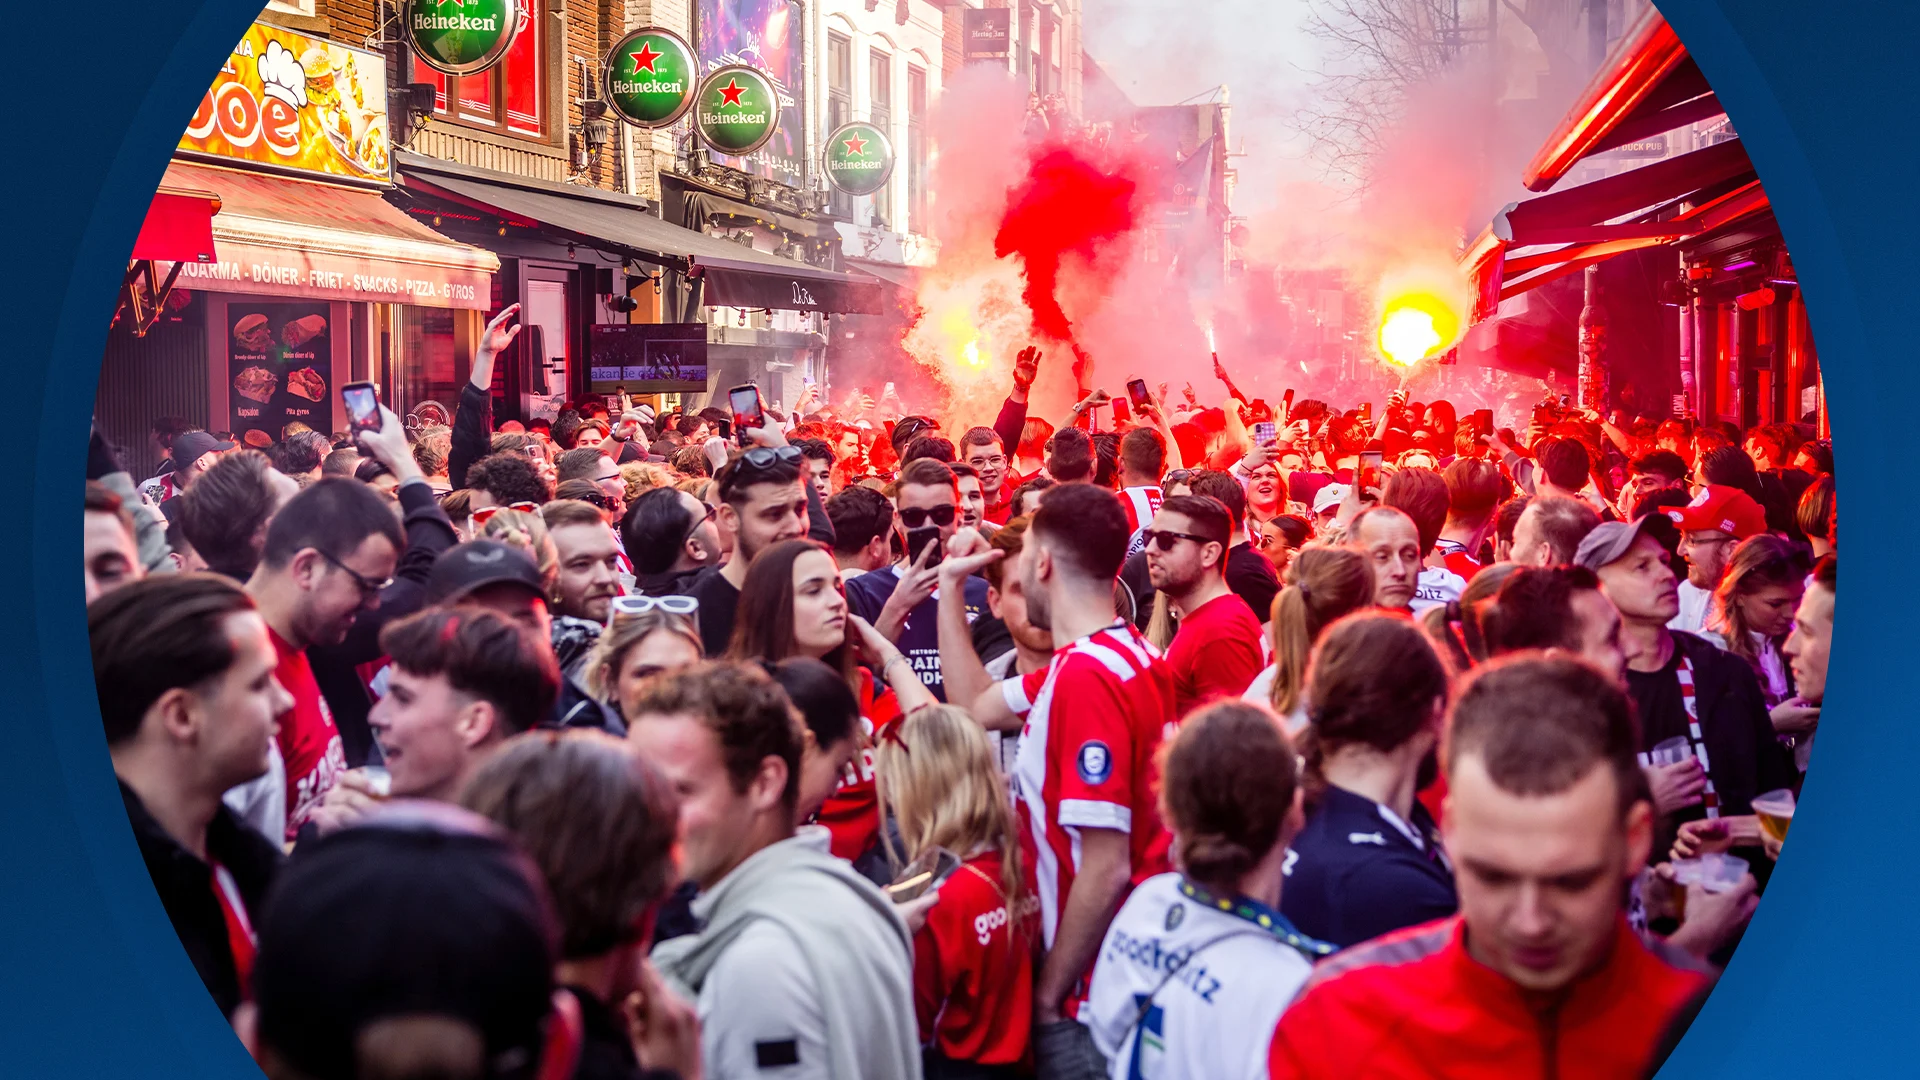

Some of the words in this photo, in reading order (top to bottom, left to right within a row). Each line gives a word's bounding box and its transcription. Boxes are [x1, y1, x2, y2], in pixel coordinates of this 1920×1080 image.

[414, 13, 496, 31] Heineken
[613, 78, 682, 94] Heineken
[702, 111, 765, 125] Heineken
[1622, 143, 1644, 151] DUCK
[1645, 142, 1663, 150] PUB
[831, 160, 882, 170] Heineken
[252, 261, 299, 286] DÖNER
[309, 270, 344, 290] FRIET
[353, 273, 398, 294] SNACKS
[405, 279, 436, 297] PIZZA
[443, 283, 475, 300] GYROS
[592, 368, 635, 379] akanie
